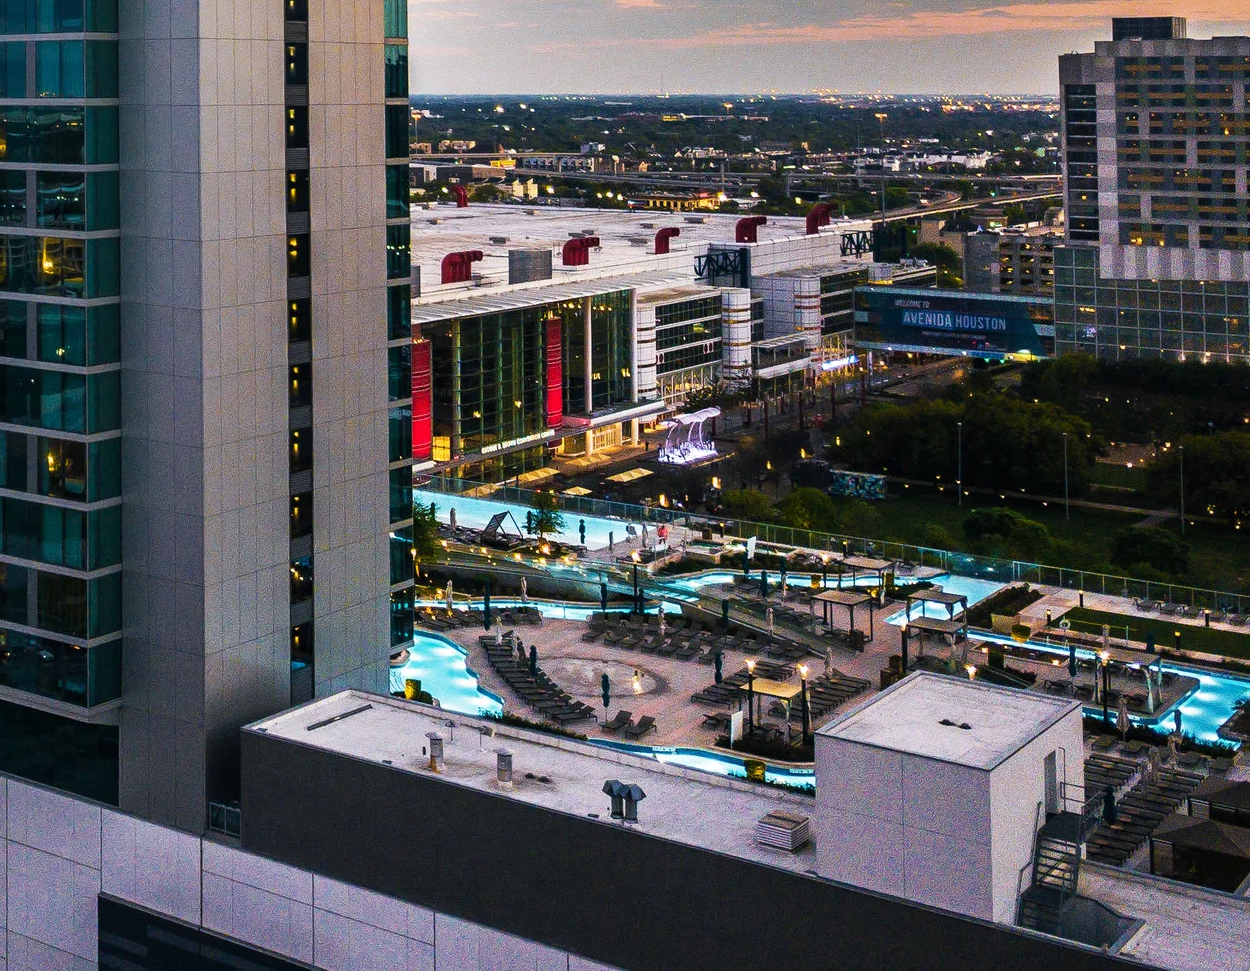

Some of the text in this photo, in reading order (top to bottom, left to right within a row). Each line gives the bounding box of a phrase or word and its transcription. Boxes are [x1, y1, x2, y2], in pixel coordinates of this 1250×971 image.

[894, 299, 930, 308] WELCOME TO
[903, 311, 1007, 330] AVENIDA HOUSTON
